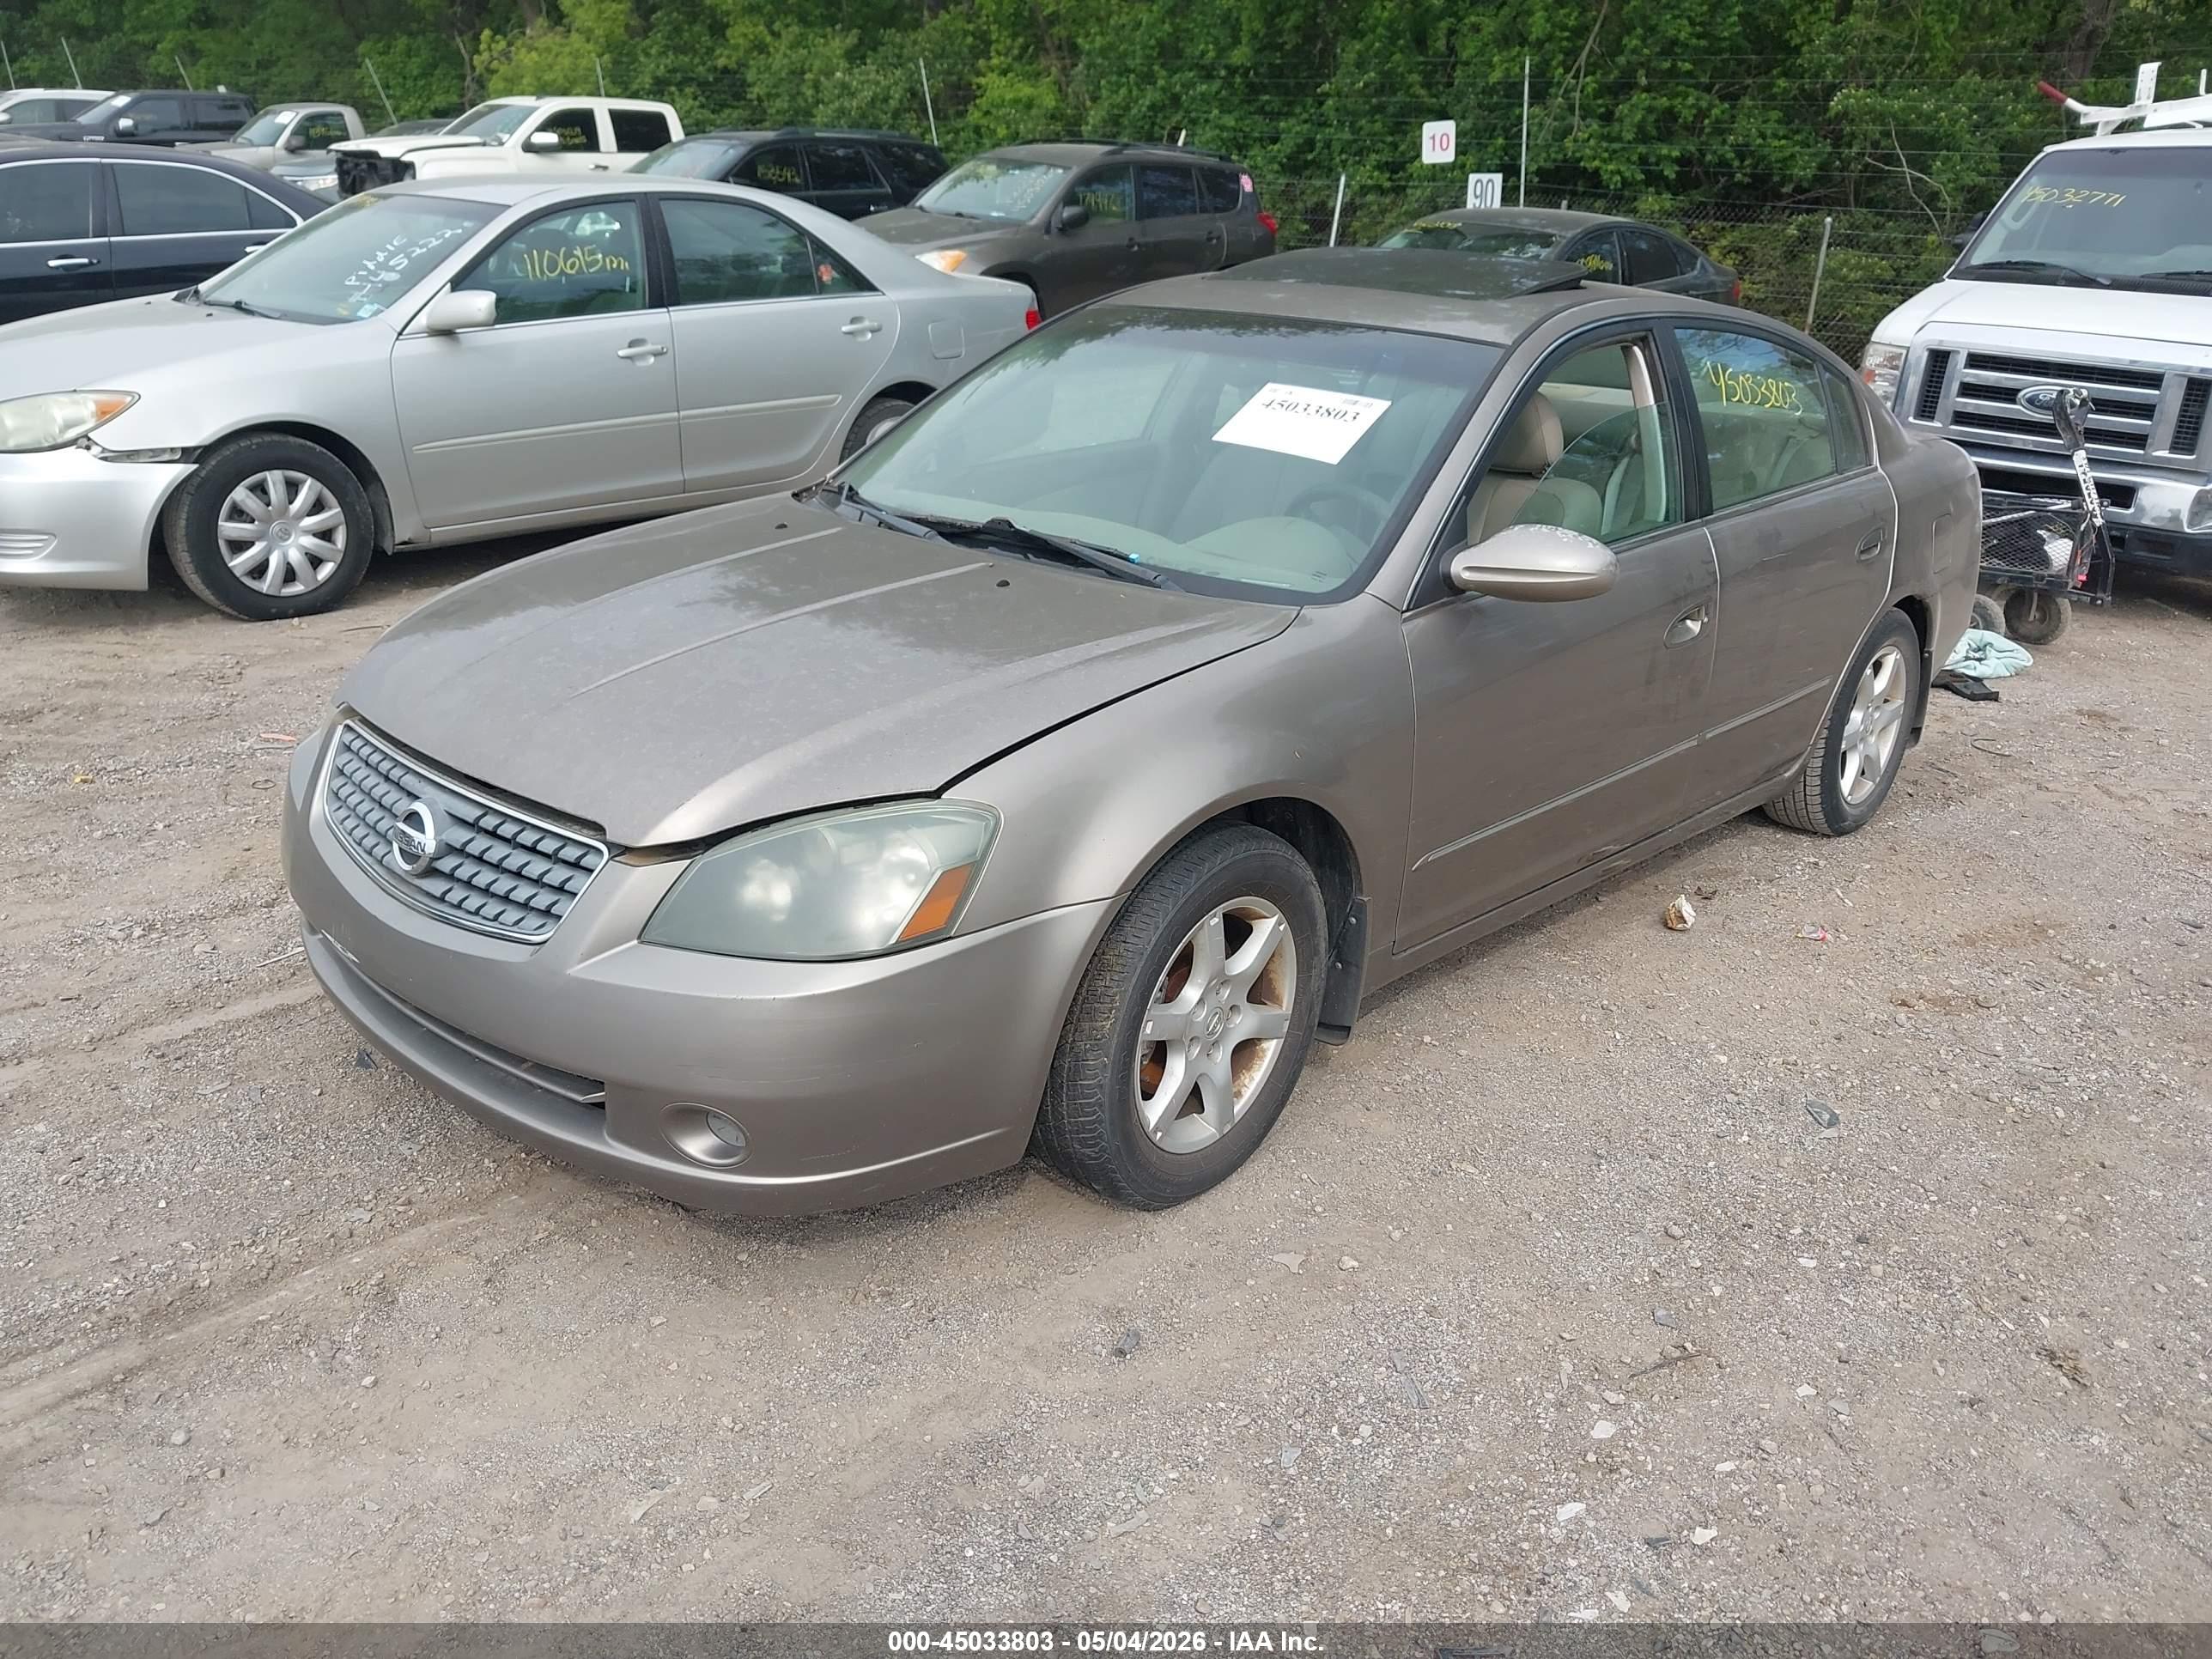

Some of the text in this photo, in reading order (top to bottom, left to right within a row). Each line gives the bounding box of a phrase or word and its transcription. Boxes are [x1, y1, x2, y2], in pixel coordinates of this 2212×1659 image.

[1429, 133, 1450, 152] 10
[1474, 178, 1495, 209] 90
[1705, 361, 1802, 416] 45033803
[1261, 398, 1361, 423] 45033803
